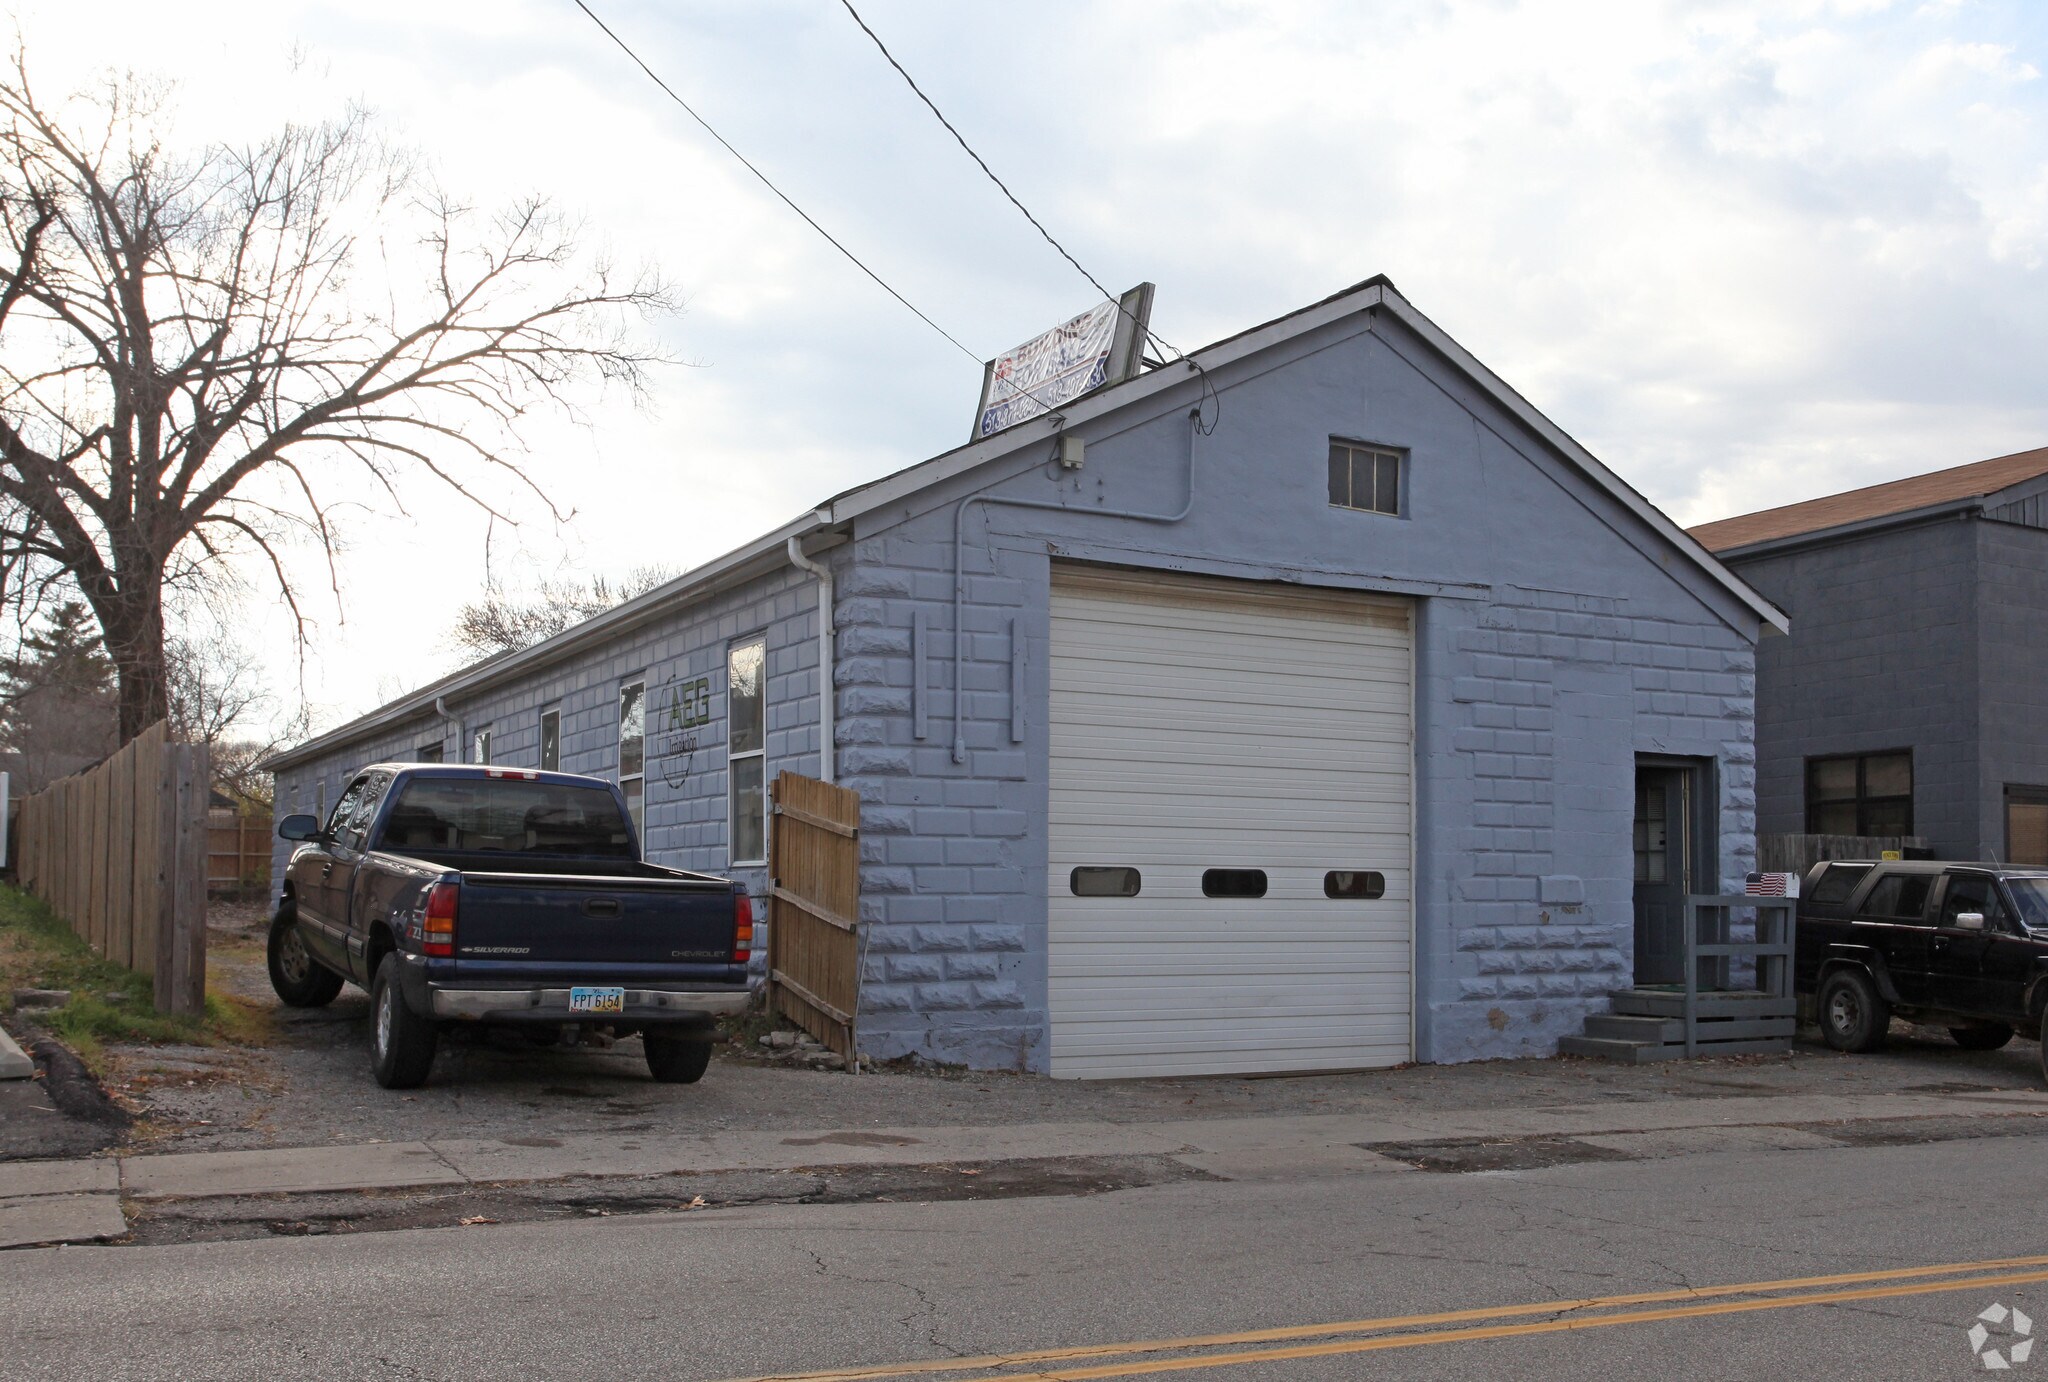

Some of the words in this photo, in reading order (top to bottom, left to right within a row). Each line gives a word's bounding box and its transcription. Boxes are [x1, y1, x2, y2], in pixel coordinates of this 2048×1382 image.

[668, 677, 710, 732] AEG
[472, 946, 530, 954] SILVERADO
[671, 950, 727, 958] CHEVROLET
[573, 994, 593, 1008] FPT
[595, 994, 620, 1008] 6154
